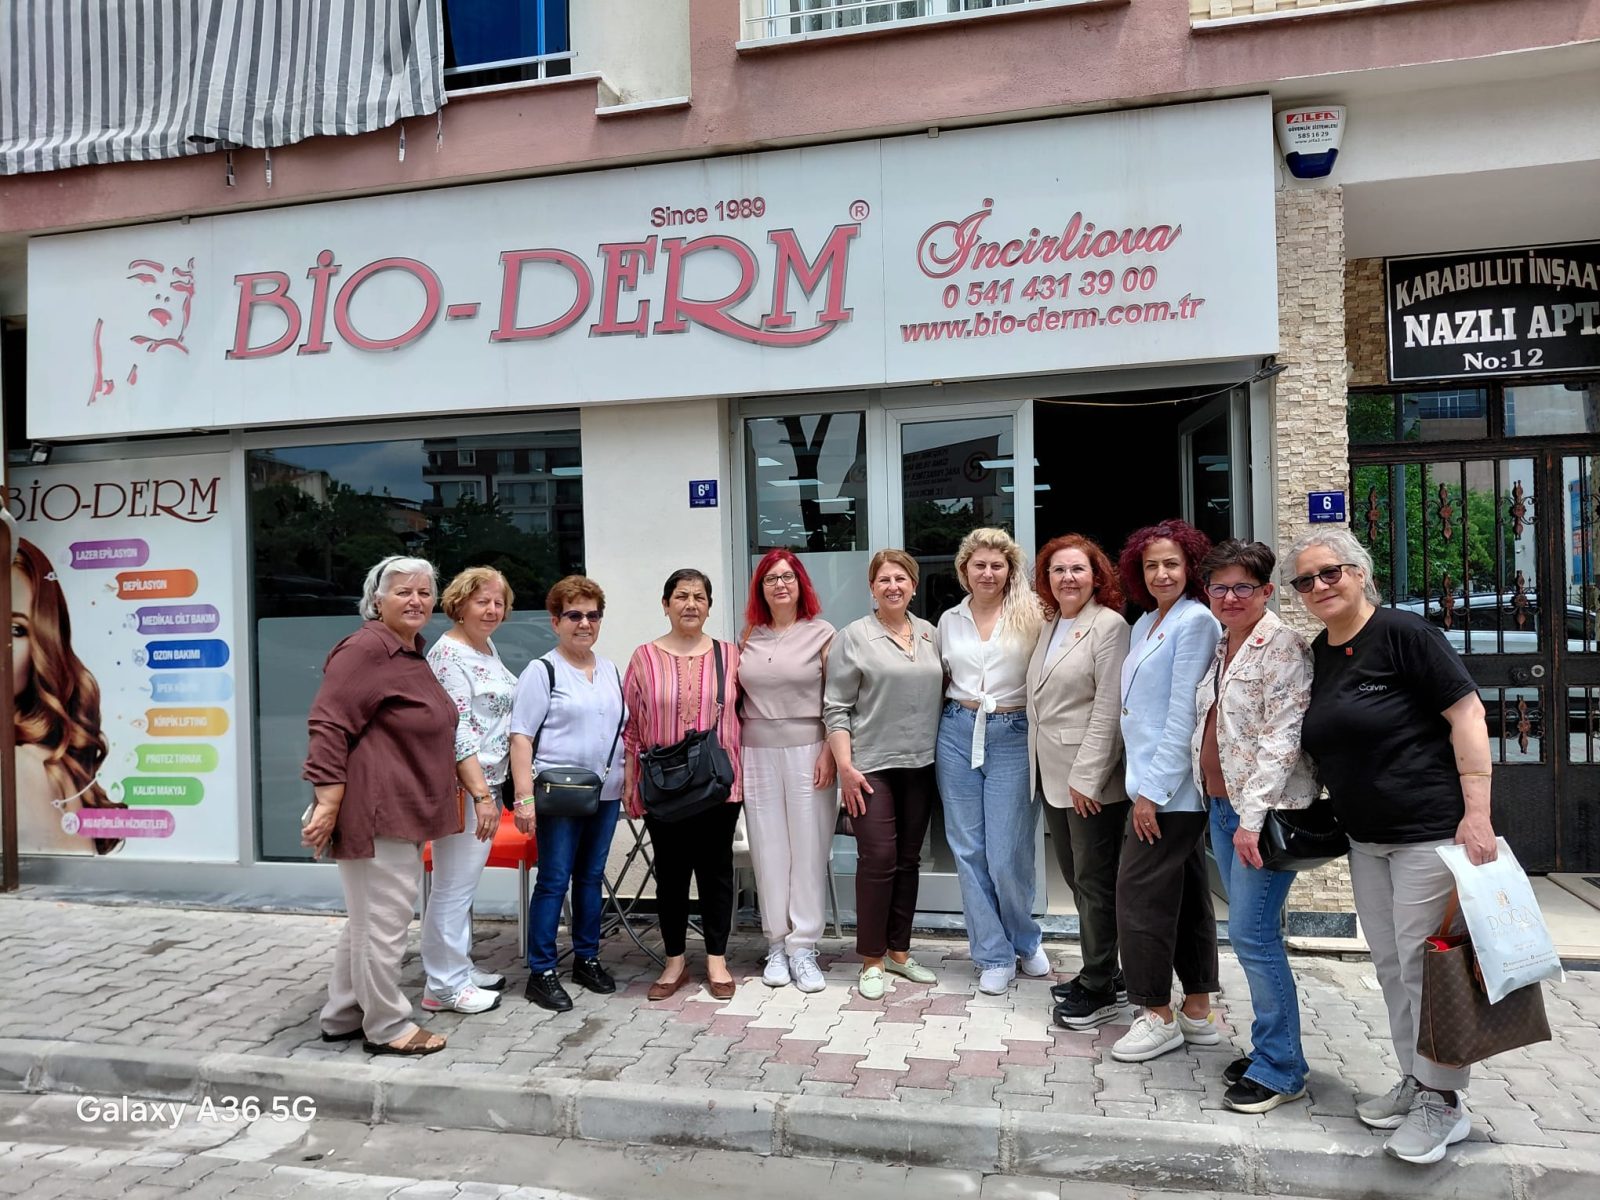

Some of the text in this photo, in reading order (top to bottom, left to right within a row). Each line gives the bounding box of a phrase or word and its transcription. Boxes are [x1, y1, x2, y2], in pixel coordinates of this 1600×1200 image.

[1289, 111, 1339, 124] ALFA
[650, 196, 766, 228] Since 1989
[917, 197, 1183, 279] İncirliova
[225, 223, 862, 360] BİO-DERM
[942, 265, 1158, 309] 0 541 431 39 00
[1395, 257, 1524, 311] KARABULUT
[900, 292, 1206, 344] www.bio-derm.com.tr
[1403, 307, 1517, 348] NAZLI
[1463, 348, 1544, 371] No:12
[1322, 496, 1332, 510] 6
[75, 547, 138, 561] LAZER EPİLASYON
[122, 578, 168, 591] DEPİLASYON
[142, 613, 174, 626] MEDİKAL
[175, 612, 190, 625] CİLT
[153, 650, 173, 661] OZON
[1358, 682, 1388, 691] Calvin
[132, 785, 187, 796] KALICI MAKYAJ
